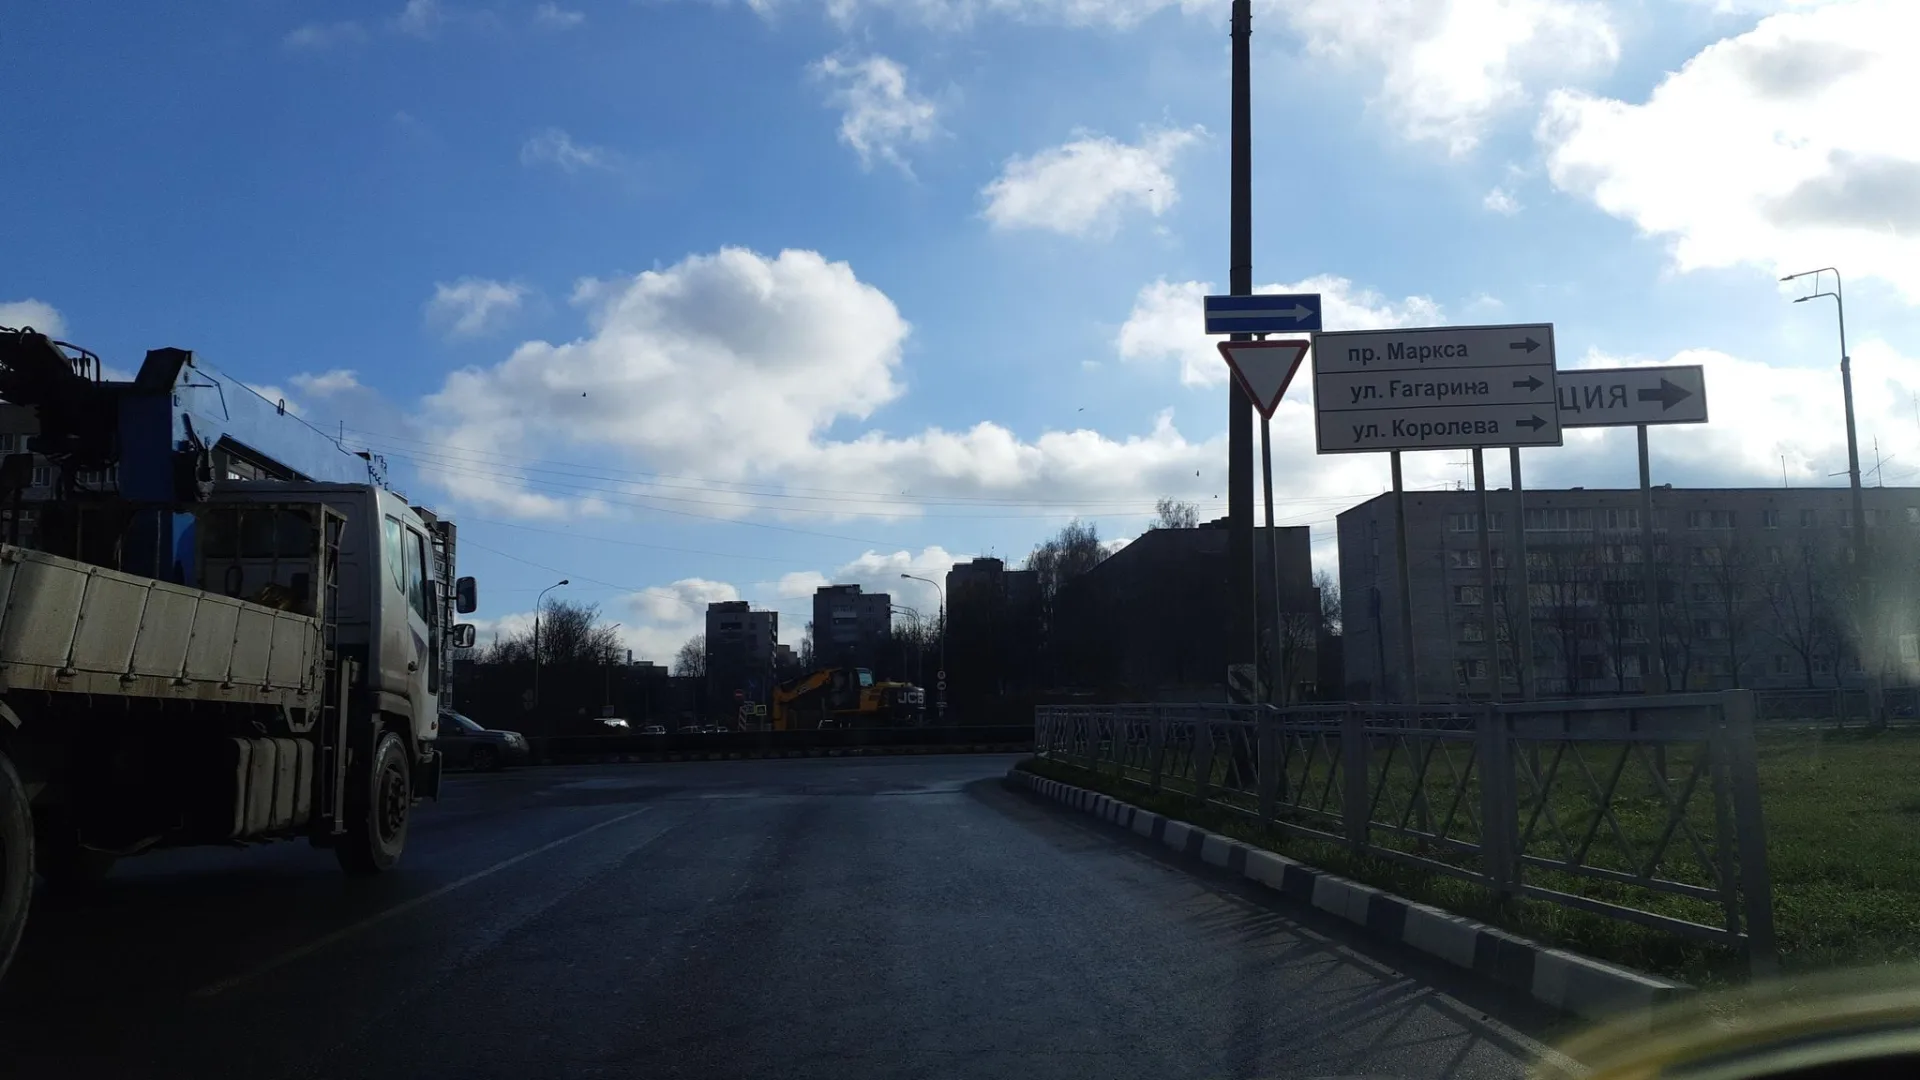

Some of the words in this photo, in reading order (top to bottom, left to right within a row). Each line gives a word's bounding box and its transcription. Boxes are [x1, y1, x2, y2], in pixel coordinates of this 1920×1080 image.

[1348, 347, 1381, 365] пр.
[1387, 343, 1468, 363] Маркса
[1350, 385, 1384, 404] ул.
[1352, 424, 1386, 443] ул.
[1392, 419, 1499, 440] Королева
[897, 691, 925, 704] JCB
